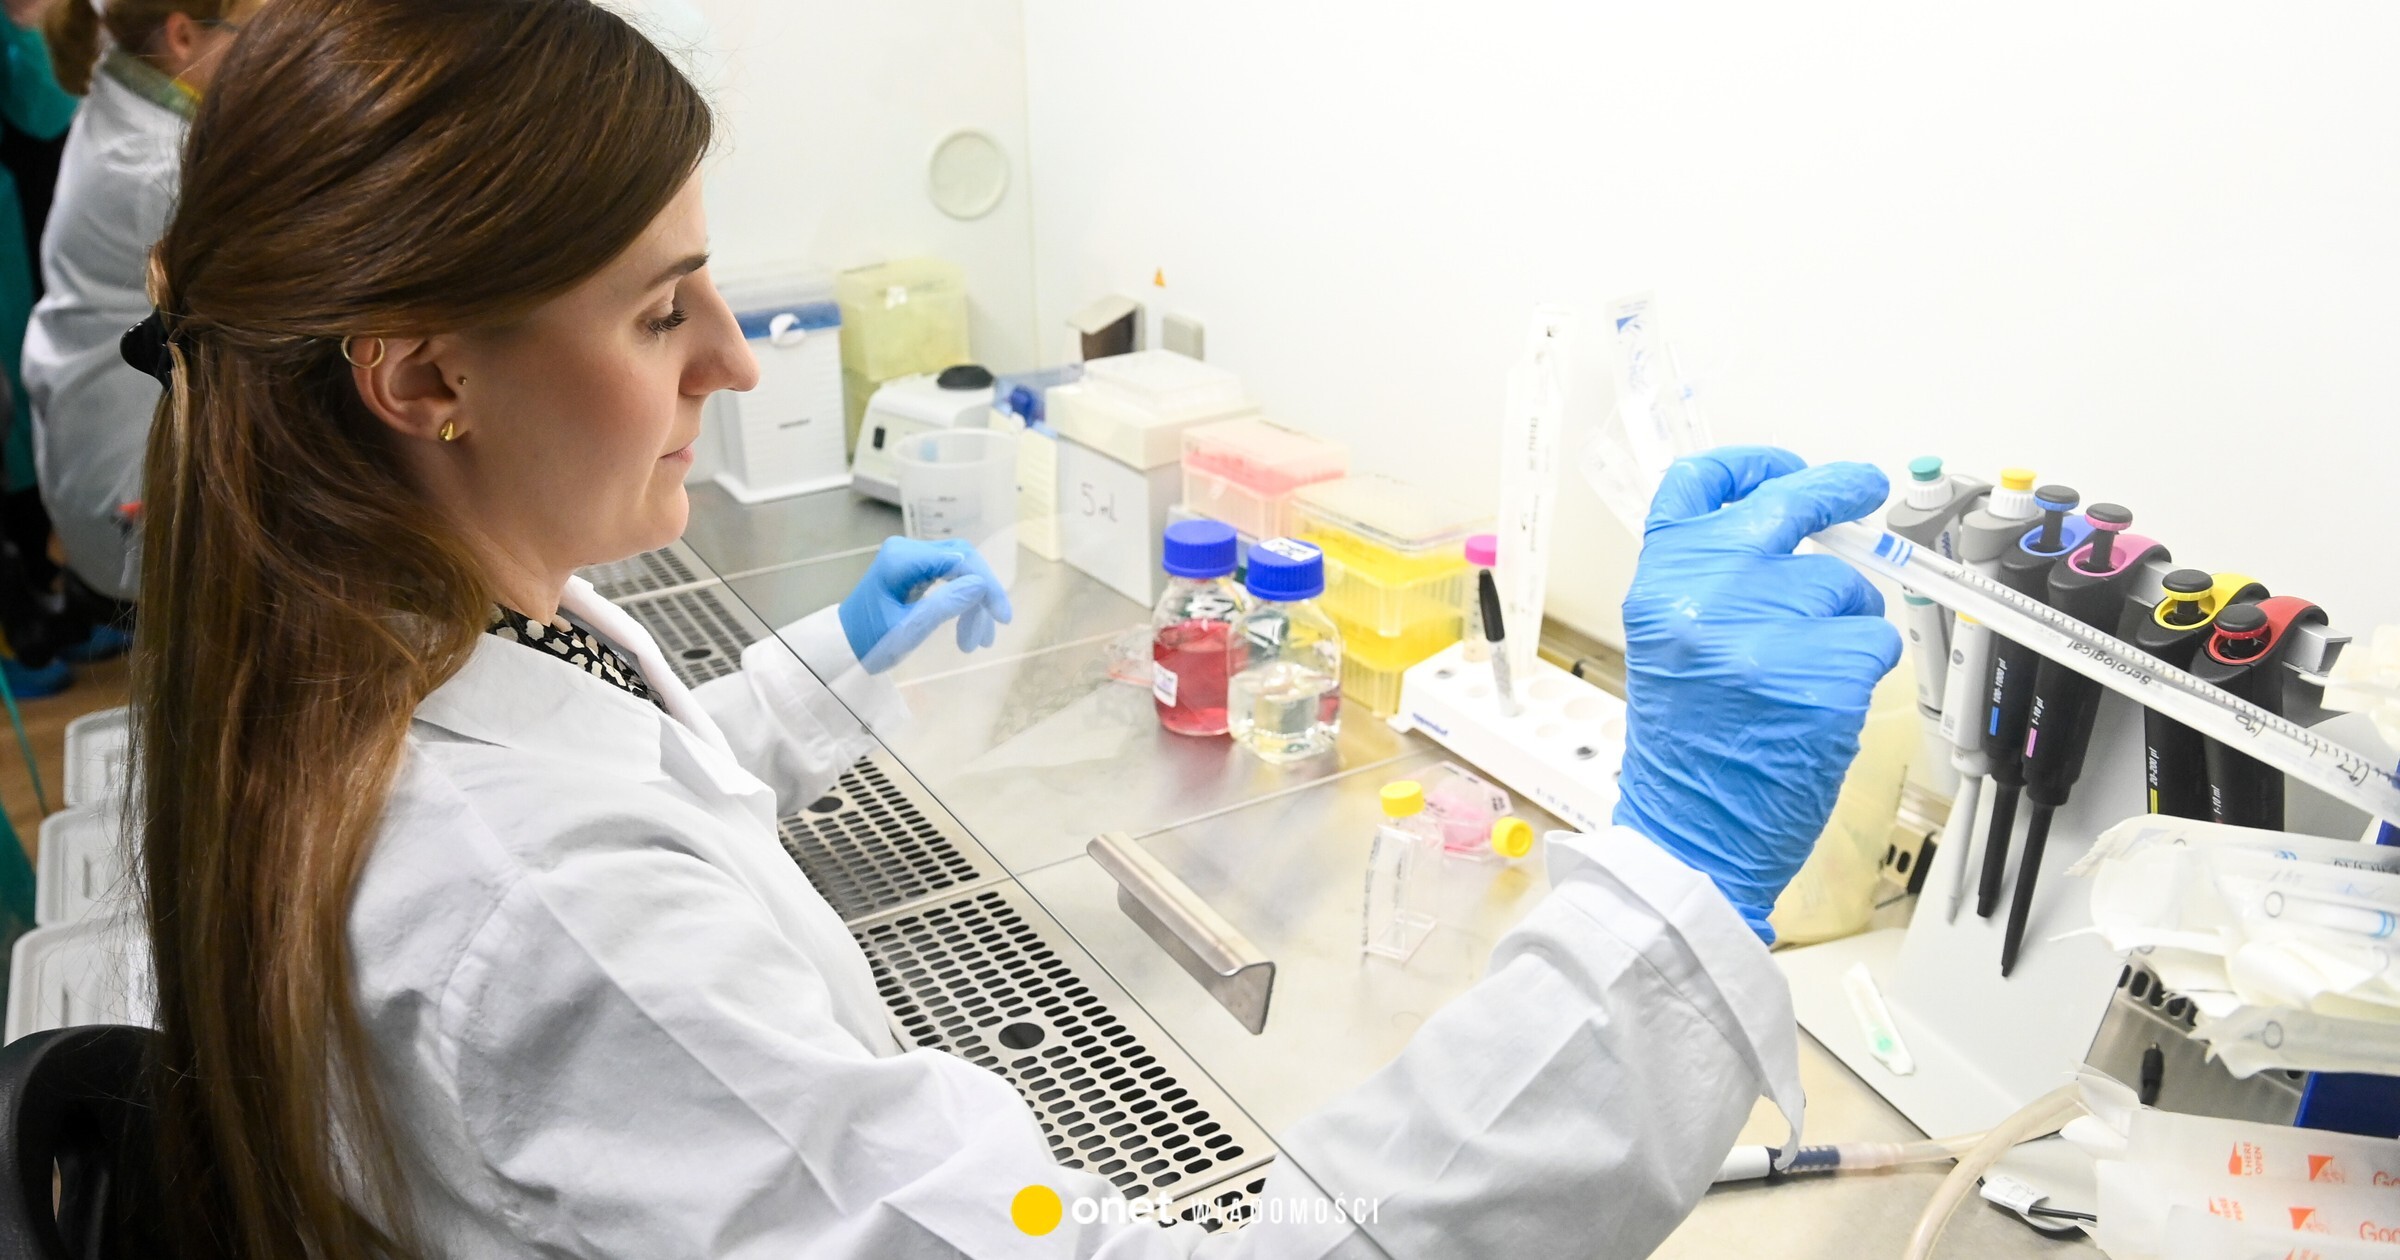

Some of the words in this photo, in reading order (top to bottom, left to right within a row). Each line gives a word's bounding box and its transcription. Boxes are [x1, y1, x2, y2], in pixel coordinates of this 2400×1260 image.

[1081, 482, 1096, 517] 5
[2067, 640, 2152, 685] Serological
[1992, 667, 2005, 704] 100-1000
[2032, 705, 2042, 726] 1-10
[2148, 757, 2158, 787] 20-200
[2212, 796, 2222, 815] 1-10
